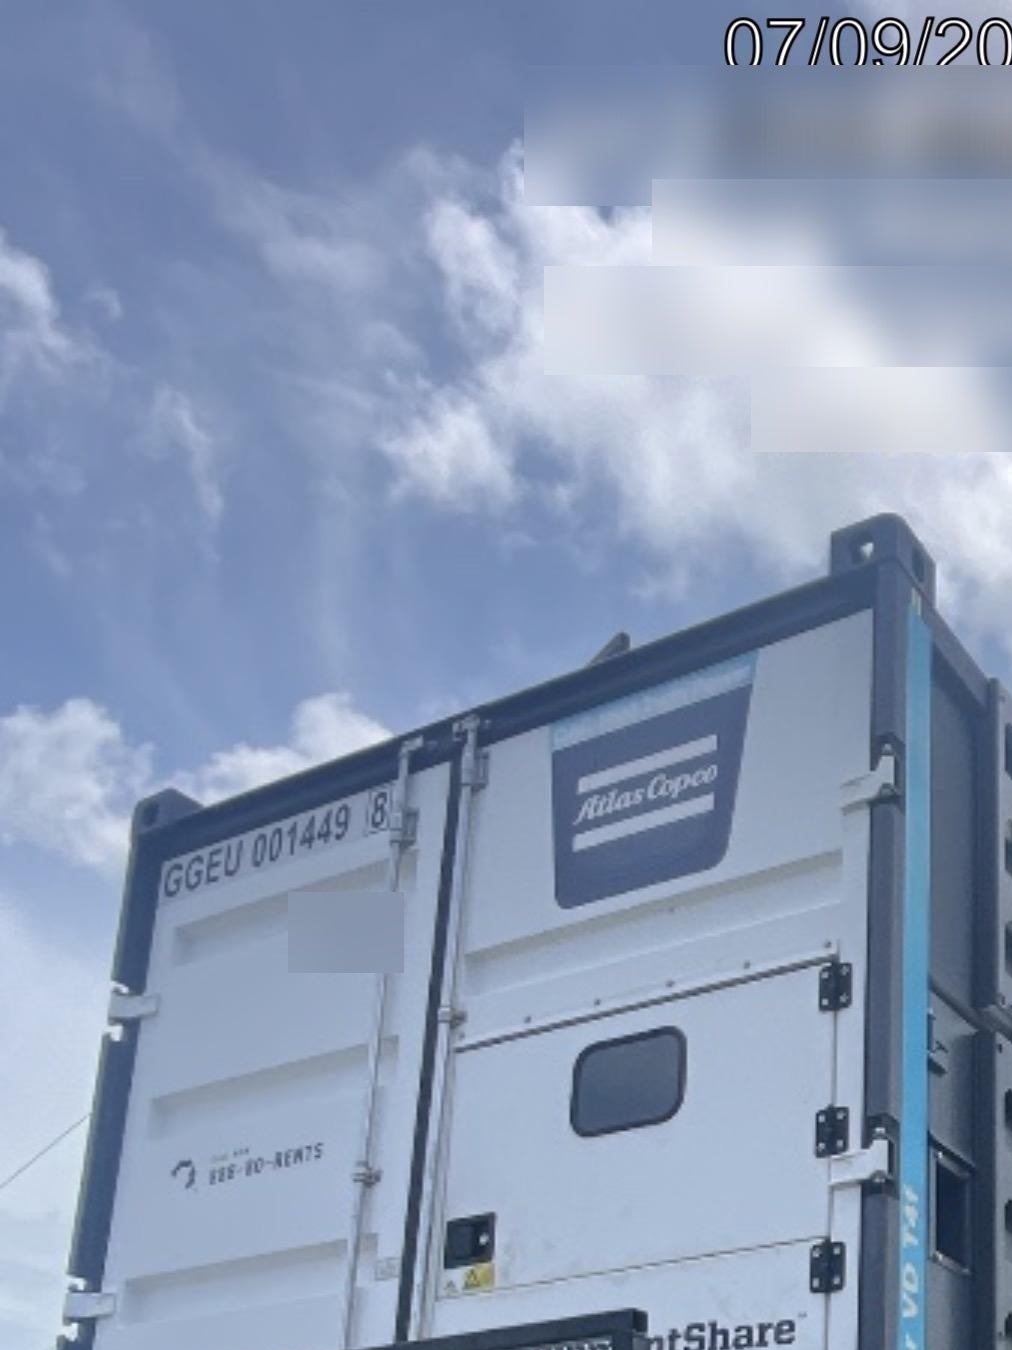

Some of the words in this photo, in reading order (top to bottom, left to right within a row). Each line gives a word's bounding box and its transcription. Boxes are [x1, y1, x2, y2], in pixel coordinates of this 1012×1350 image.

[573, 787, 645, 826] Atlas
[647, 763, 718, 799] Copco
[163, 838, 244, 897] GGEU
[251, 803, 350, 868] 001449
[370, 791, 388, 829] 8
[902, 1262, 919, 1318] VD
